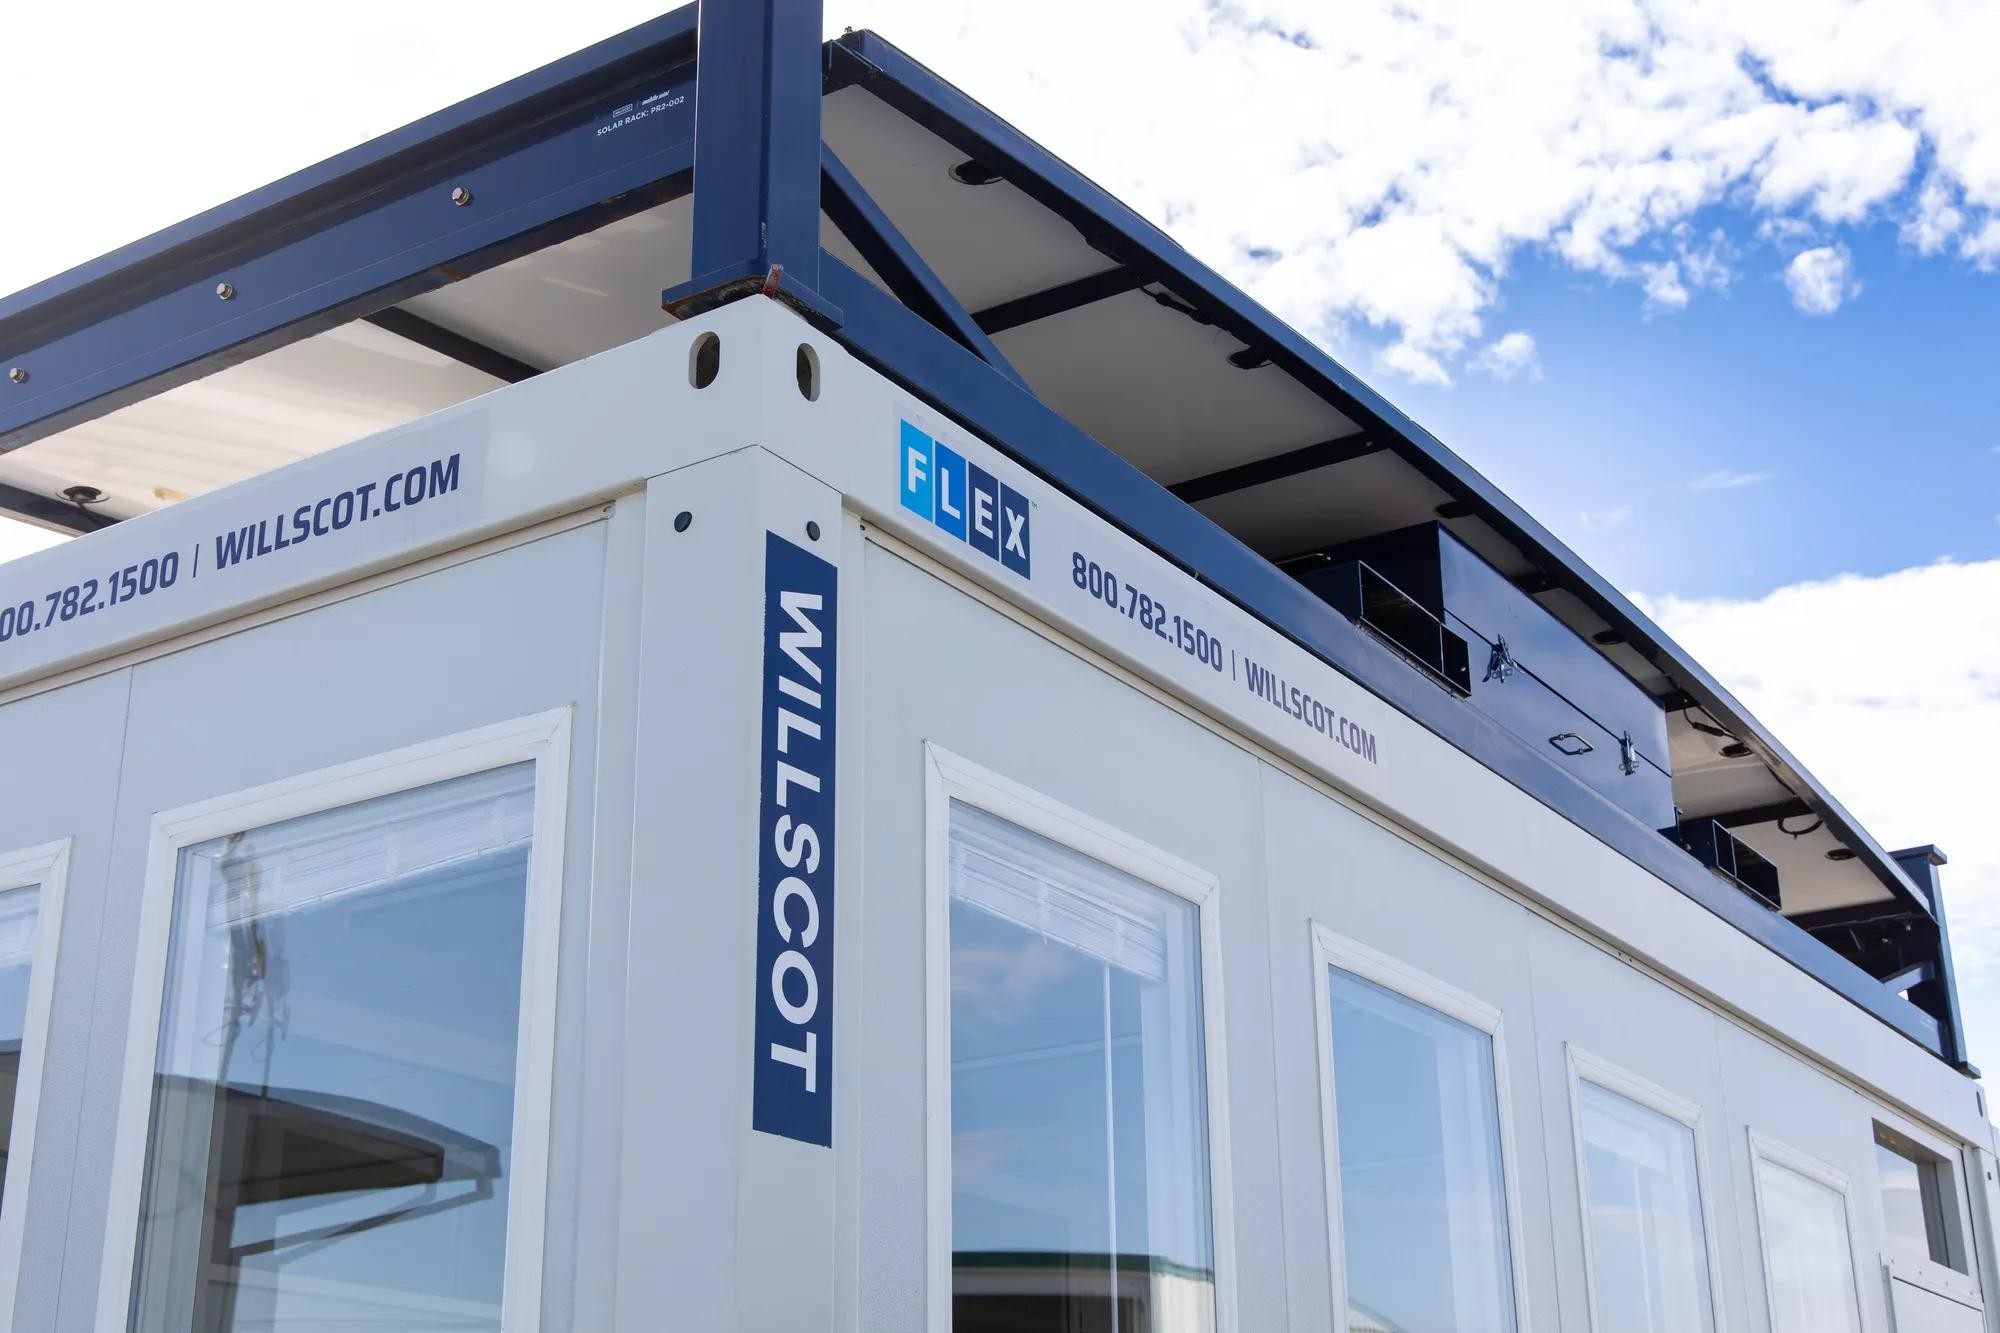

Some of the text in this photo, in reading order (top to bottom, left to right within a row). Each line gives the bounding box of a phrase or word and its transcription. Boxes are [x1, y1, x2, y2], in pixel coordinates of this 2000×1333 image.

[597, 119, 623, 136] SOLAR
[625, 110, 649, 125] RACK:
[650, 96, 685, 114] PR2-002
[216, 453, 460, 570] WILLSCOT.COM
[908, 446, 1026, 560] FLEX
[1072, 552, 1223, 673] 800.782.1500
[1245, 657, 1377, 764] WILLSCOT.COM
[771, 591, 823, 1093] WILLSCOT
